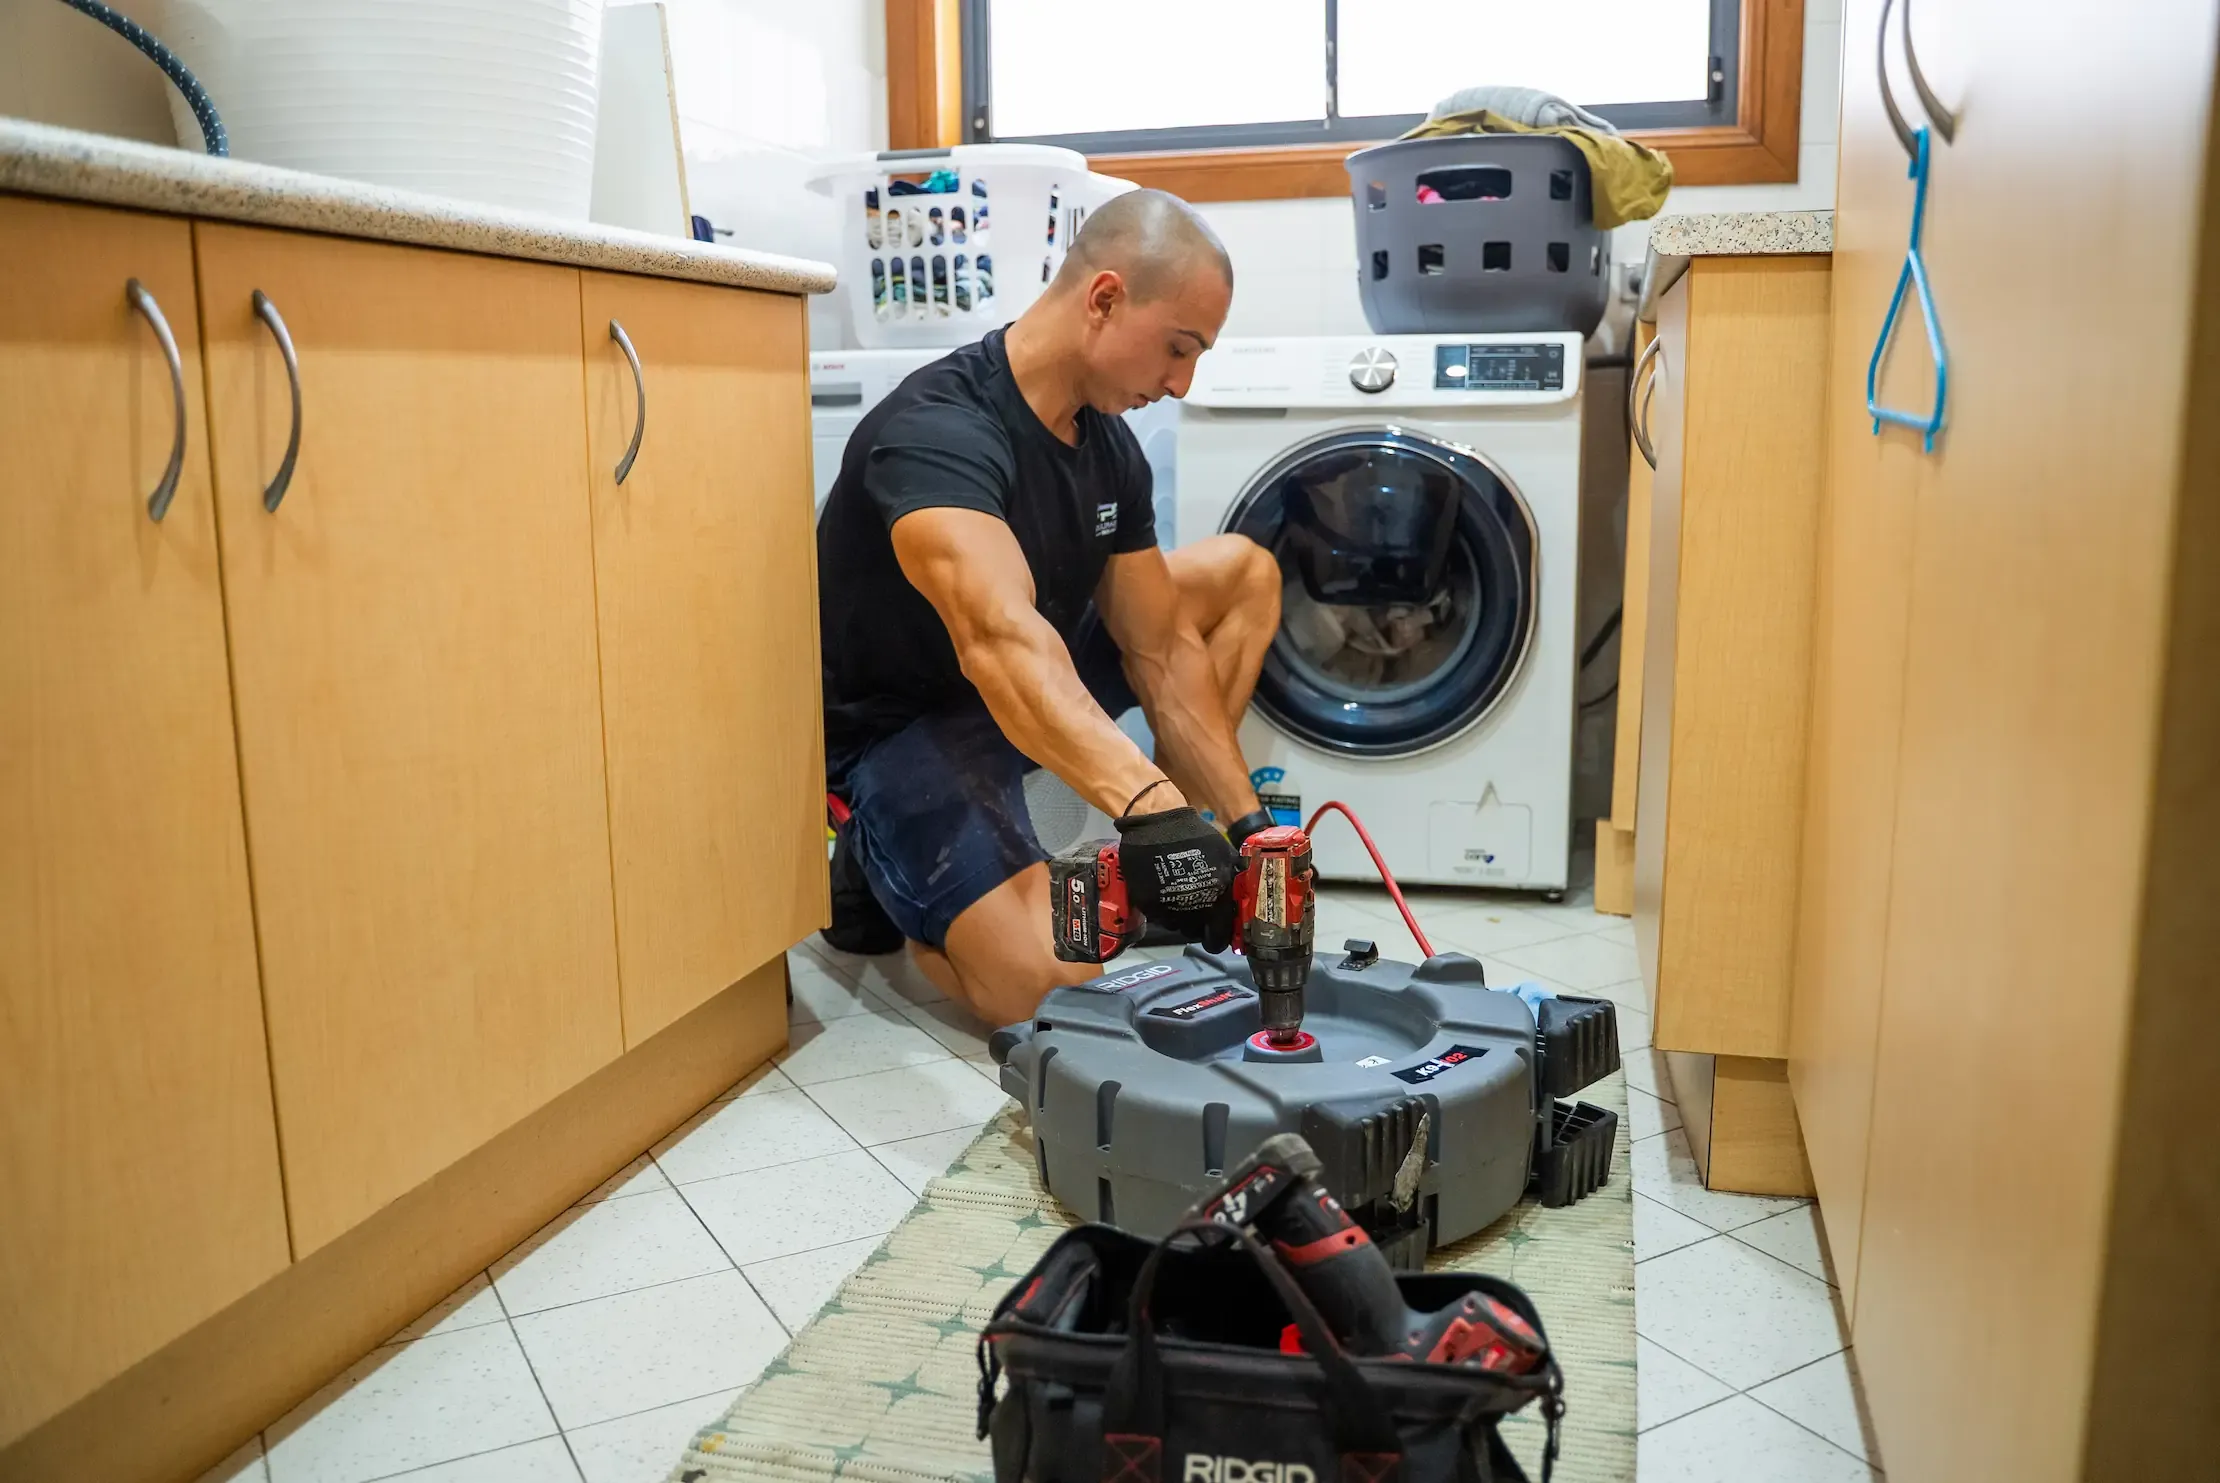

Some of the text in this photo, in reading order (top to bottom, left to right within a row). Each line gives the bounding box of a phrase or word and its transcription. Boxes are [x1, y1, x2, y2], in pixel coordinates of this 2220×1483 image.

[1071, 879, 1085, 903] 5.0
[1073, 920, 1081, 940] M18
[1095, 965, 1173, 992] RIDGID
[1184, 1453, 1318, 1483] RIDGID
